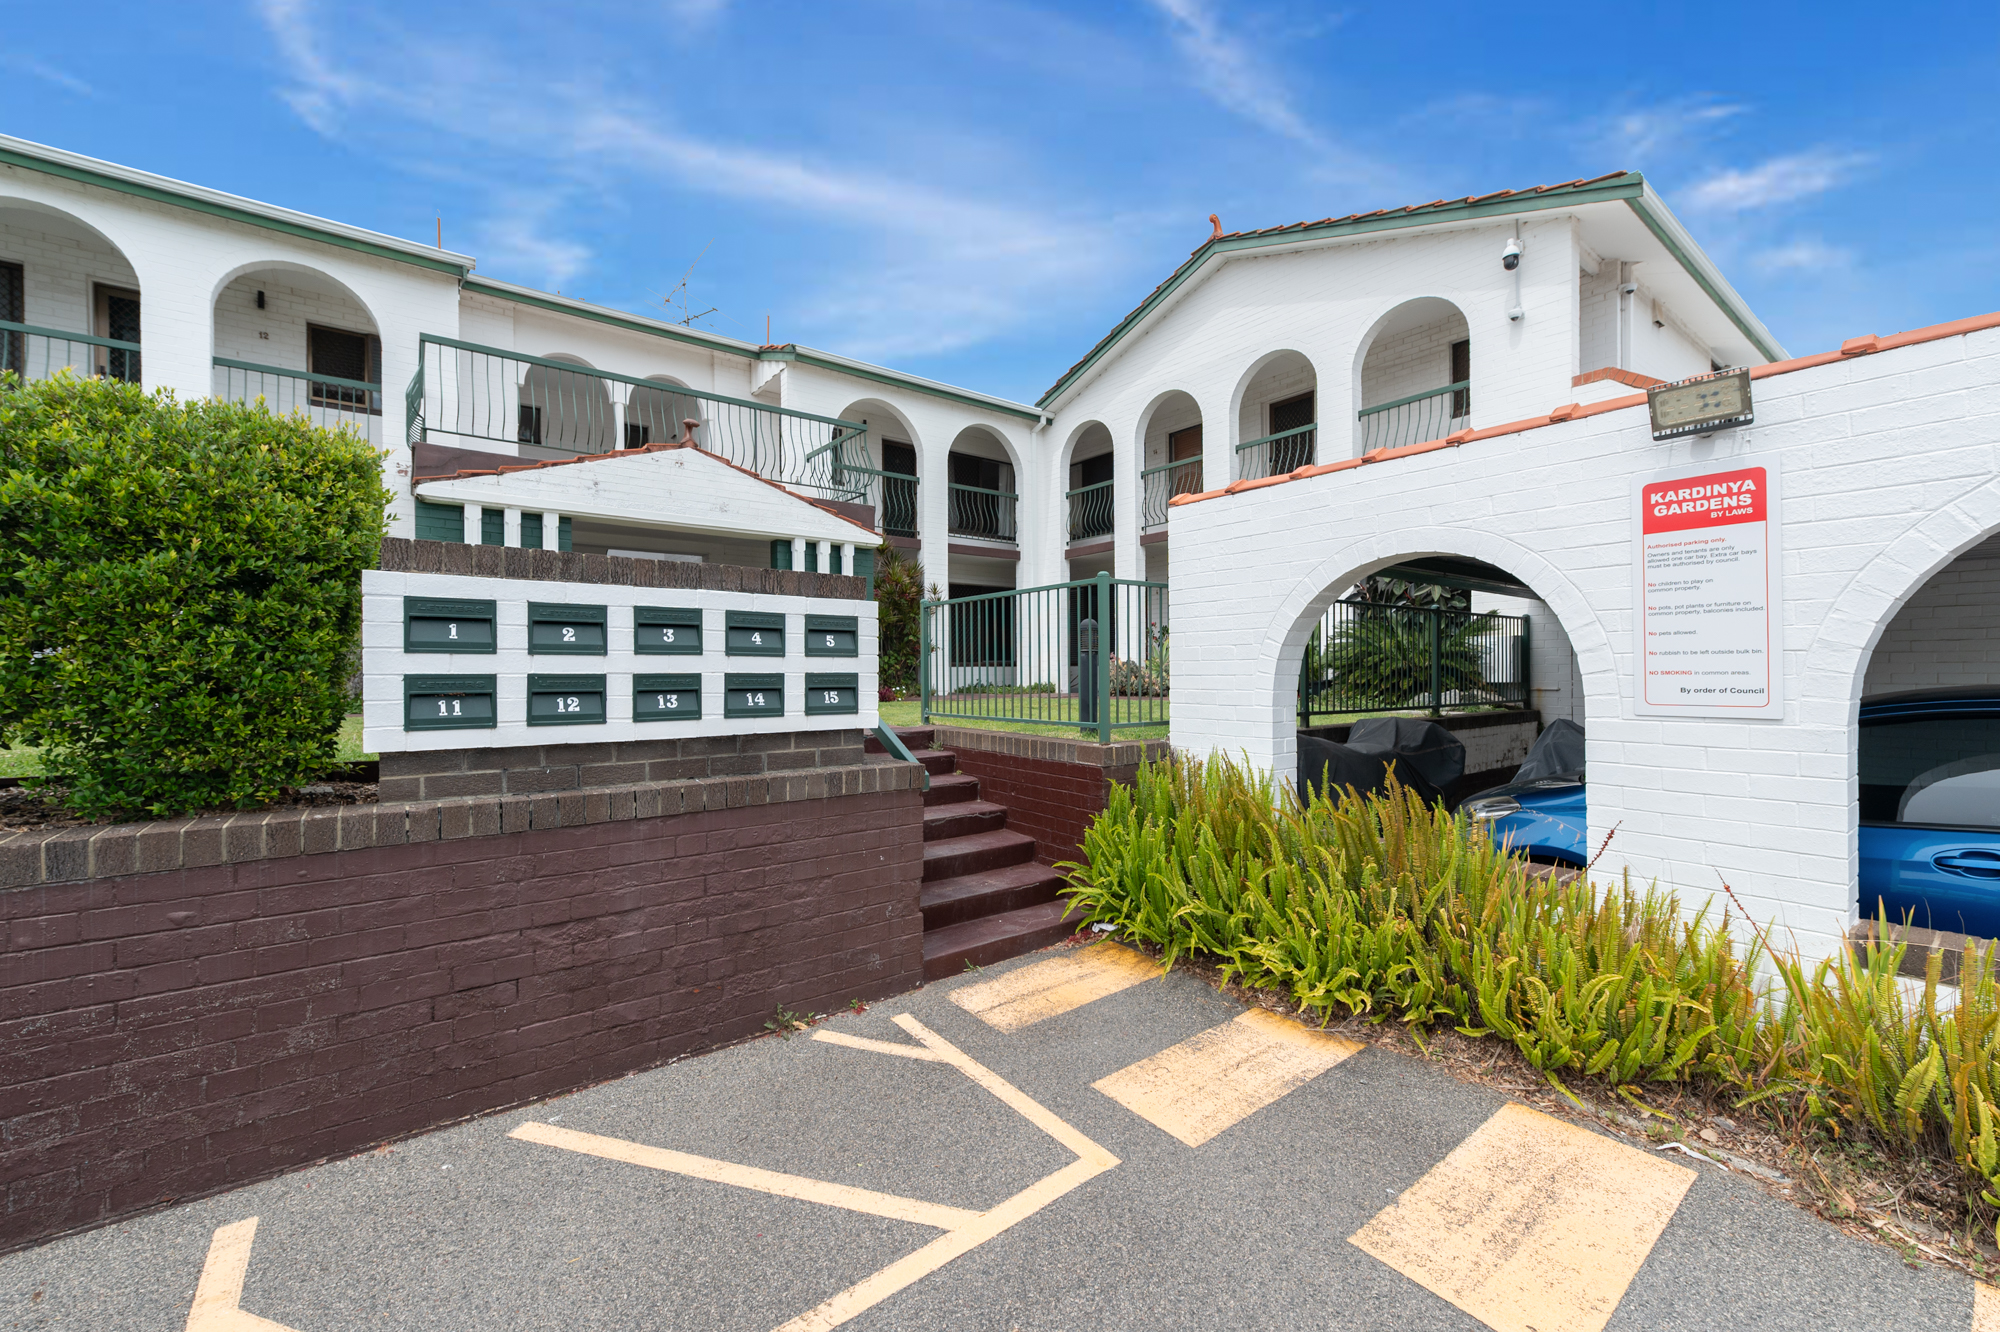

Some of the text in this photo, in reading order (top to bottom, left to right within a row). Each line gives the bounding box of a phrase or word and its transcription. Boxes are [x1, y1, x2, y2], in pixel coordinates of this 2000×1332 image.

[259, 332, 269, 340] 12
[1651, 479, 1756, 504] KARDINYA
[1654, 494, 1752, 516] GARDENS
[1726, 507, 1753, 516] LAWS
[418, 603, 485, 613] LETTERS
[539, 608, 598, 618] LETTERS
[643, 612, 694, 621] LETTERS
[734, 616, 778, 625] LETTERS
[812, 619, 851, 627] LETTERS
[449, 624, 458, 639] 1
[562, 628, 576, 641] 2
[663, 629, 674, 642] 3
[752, 632, 762, 645] 4
[826, 635, 835, 647] 5
[418, 680, 485, 689] LETTERS
[538, 680, 597, 688] LETTERS
[657, 695, 678, 708] 13
[746, 693, 765, 706] 14
[824, 691, 839, 704] 15
[438, 700, 462, 716] 11
[556, 697, 580, 712] 12
